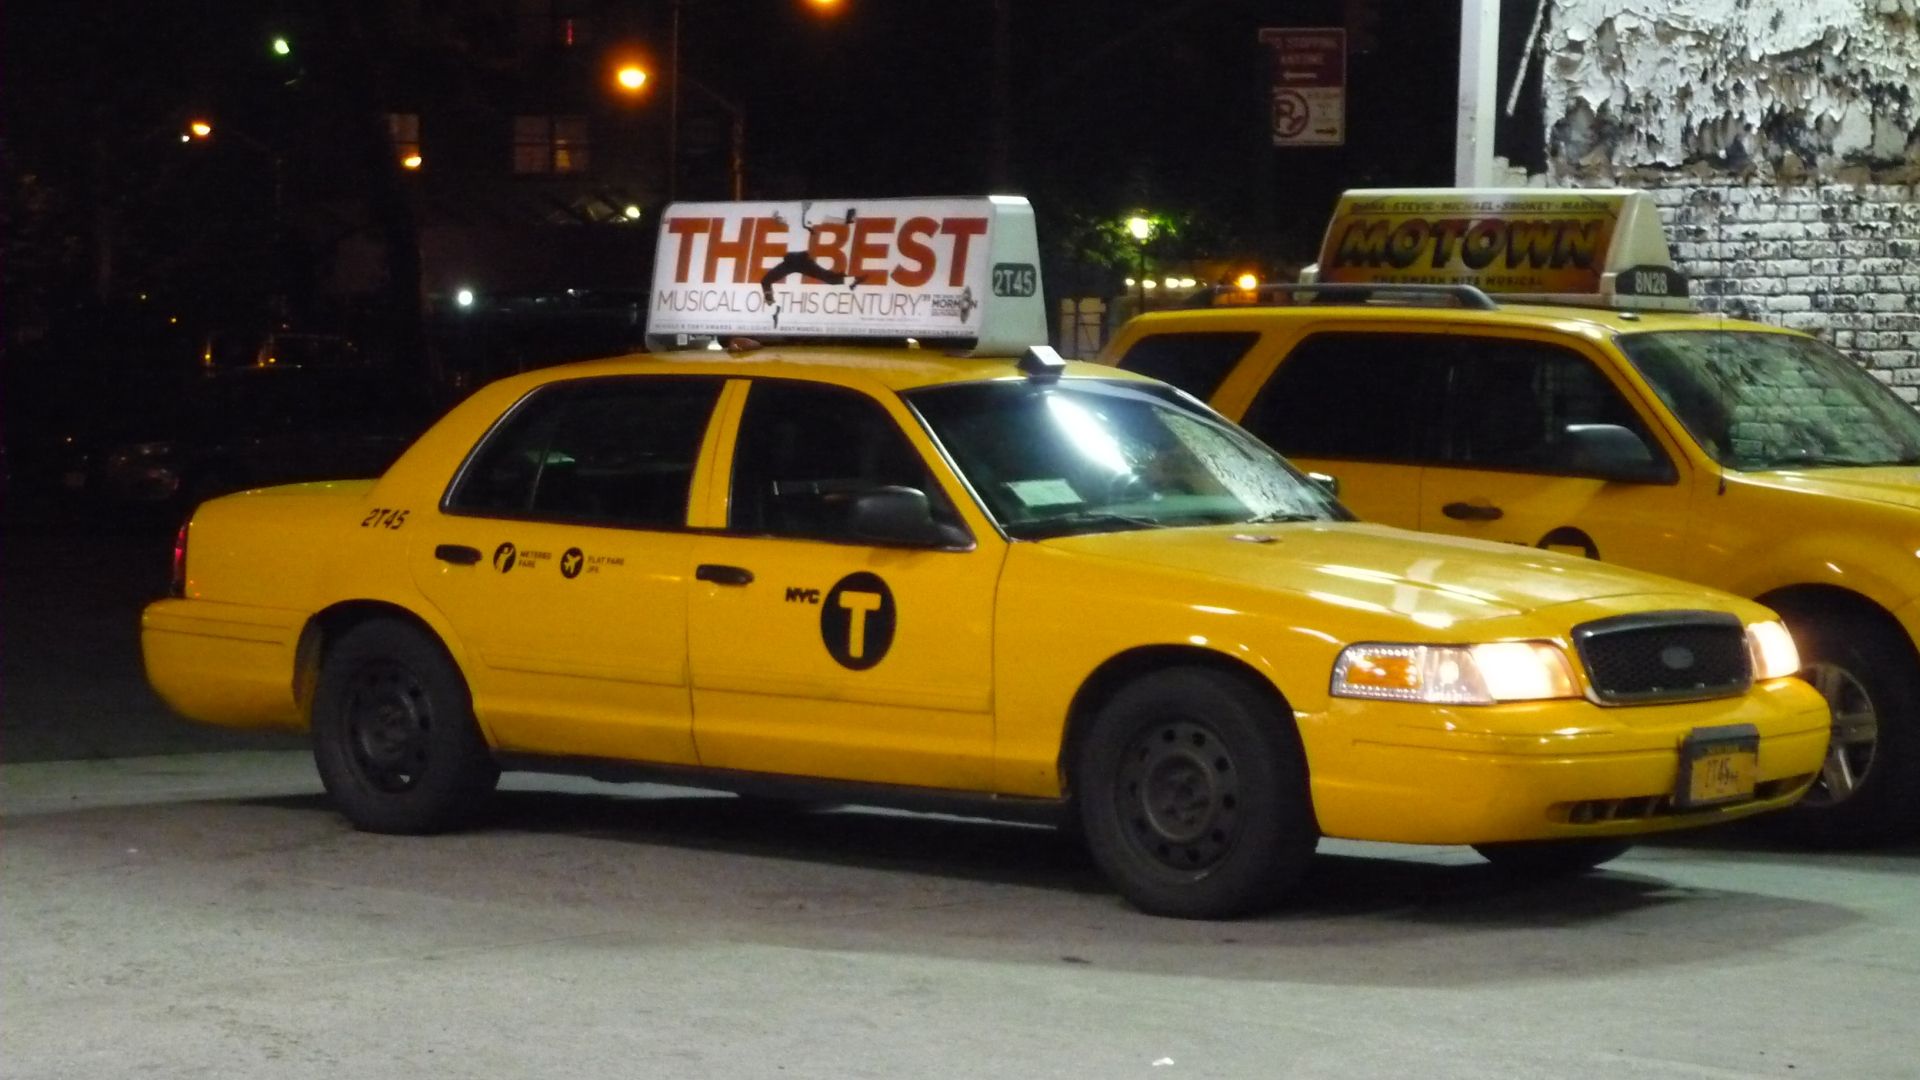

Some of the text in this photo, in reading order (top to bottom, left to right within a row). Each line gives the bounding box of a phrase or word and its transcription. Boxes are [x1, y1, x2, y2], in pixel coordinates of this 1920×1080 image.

[668, 216, 988, 287] THE BEST
[1332, 218, 1604, 270] MOTOWN
[994, 269, 1033, 295] 2T45
[1635, 271, 1668, 294] 8N28
[657, 290, 742, 313] MUSICAL
[778, 291, 820, 313] THIS
[360, 508, 409, 530] 2T45
[785, 587, 819, 604] NYC
[839, 590, 881, 658] T
